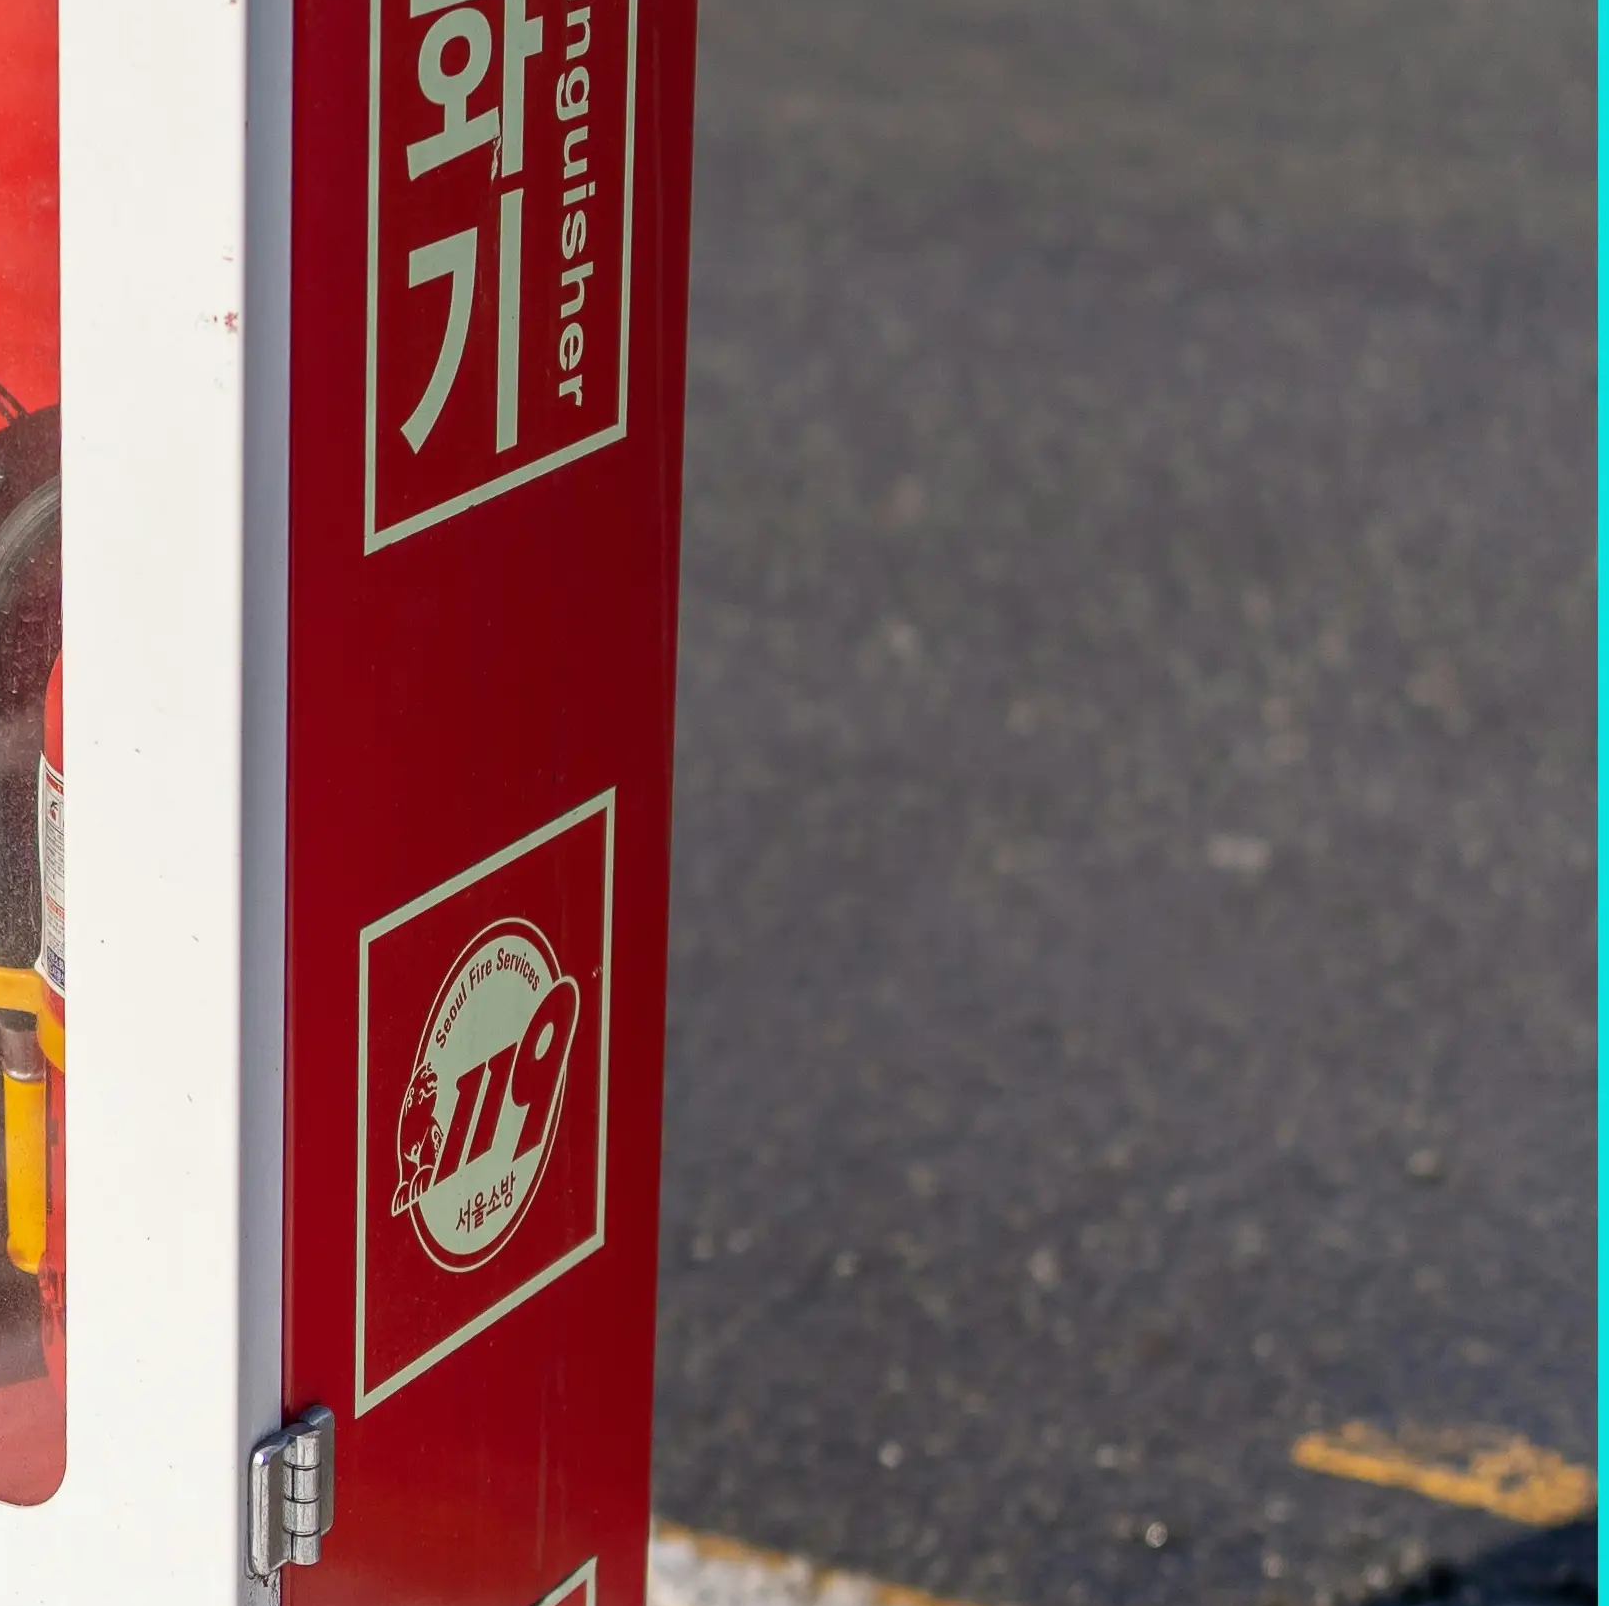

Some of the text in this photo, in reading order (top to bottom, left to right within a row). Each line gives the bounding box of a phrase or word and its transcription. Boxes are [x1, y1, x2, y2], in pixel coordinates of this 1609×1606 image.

[436, 947, 540, 1049] Seoul Fire Services
[433, 978, 576, 1187] 119
[455, 1169, 516, 1234] 서울소방
